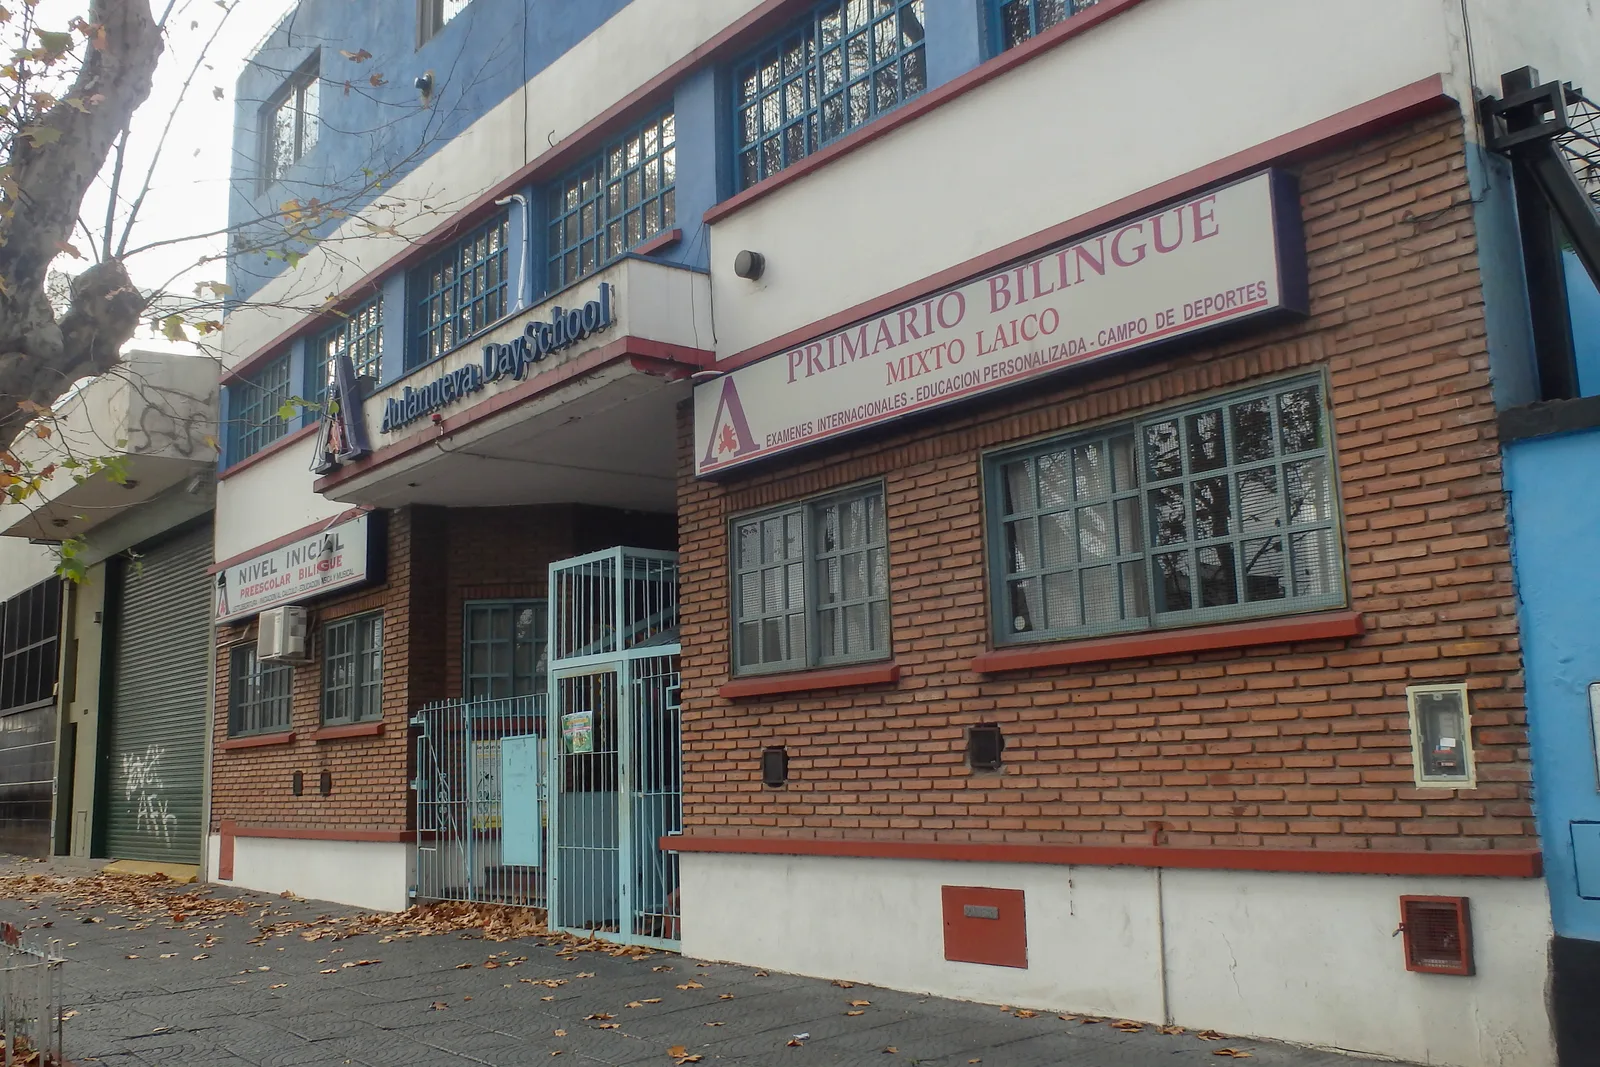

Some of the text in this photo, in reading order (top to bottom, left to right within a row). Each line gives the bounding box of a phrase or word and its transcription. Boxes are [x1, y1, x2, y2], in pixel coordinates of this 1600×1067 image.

[787, 195, 1220, 385] PRIMARIO BILINGUE
[766, 421, 813, 448] EXAMENES
[817, 392, 907, 431] INTERNACIONALES
[916, 369, 980, 402] EDUCACION
[983, 337, 1087, 382] PERSONALIZADA
[1097, 317, 1148, 347] CAMPO
[1155, 308, 1175, 330] DE
[1183, 280, 1268, 322] DEPORTES
[886, 308, 1059, 386] MIXTO LAICO
[380, 363, 478, 434] Aulanueva
[239, 558, 278, 586] NIVEL
[240, 573, 291, 599] PREESCOLAR
[298, 555, 343, 581] BILIGUE
